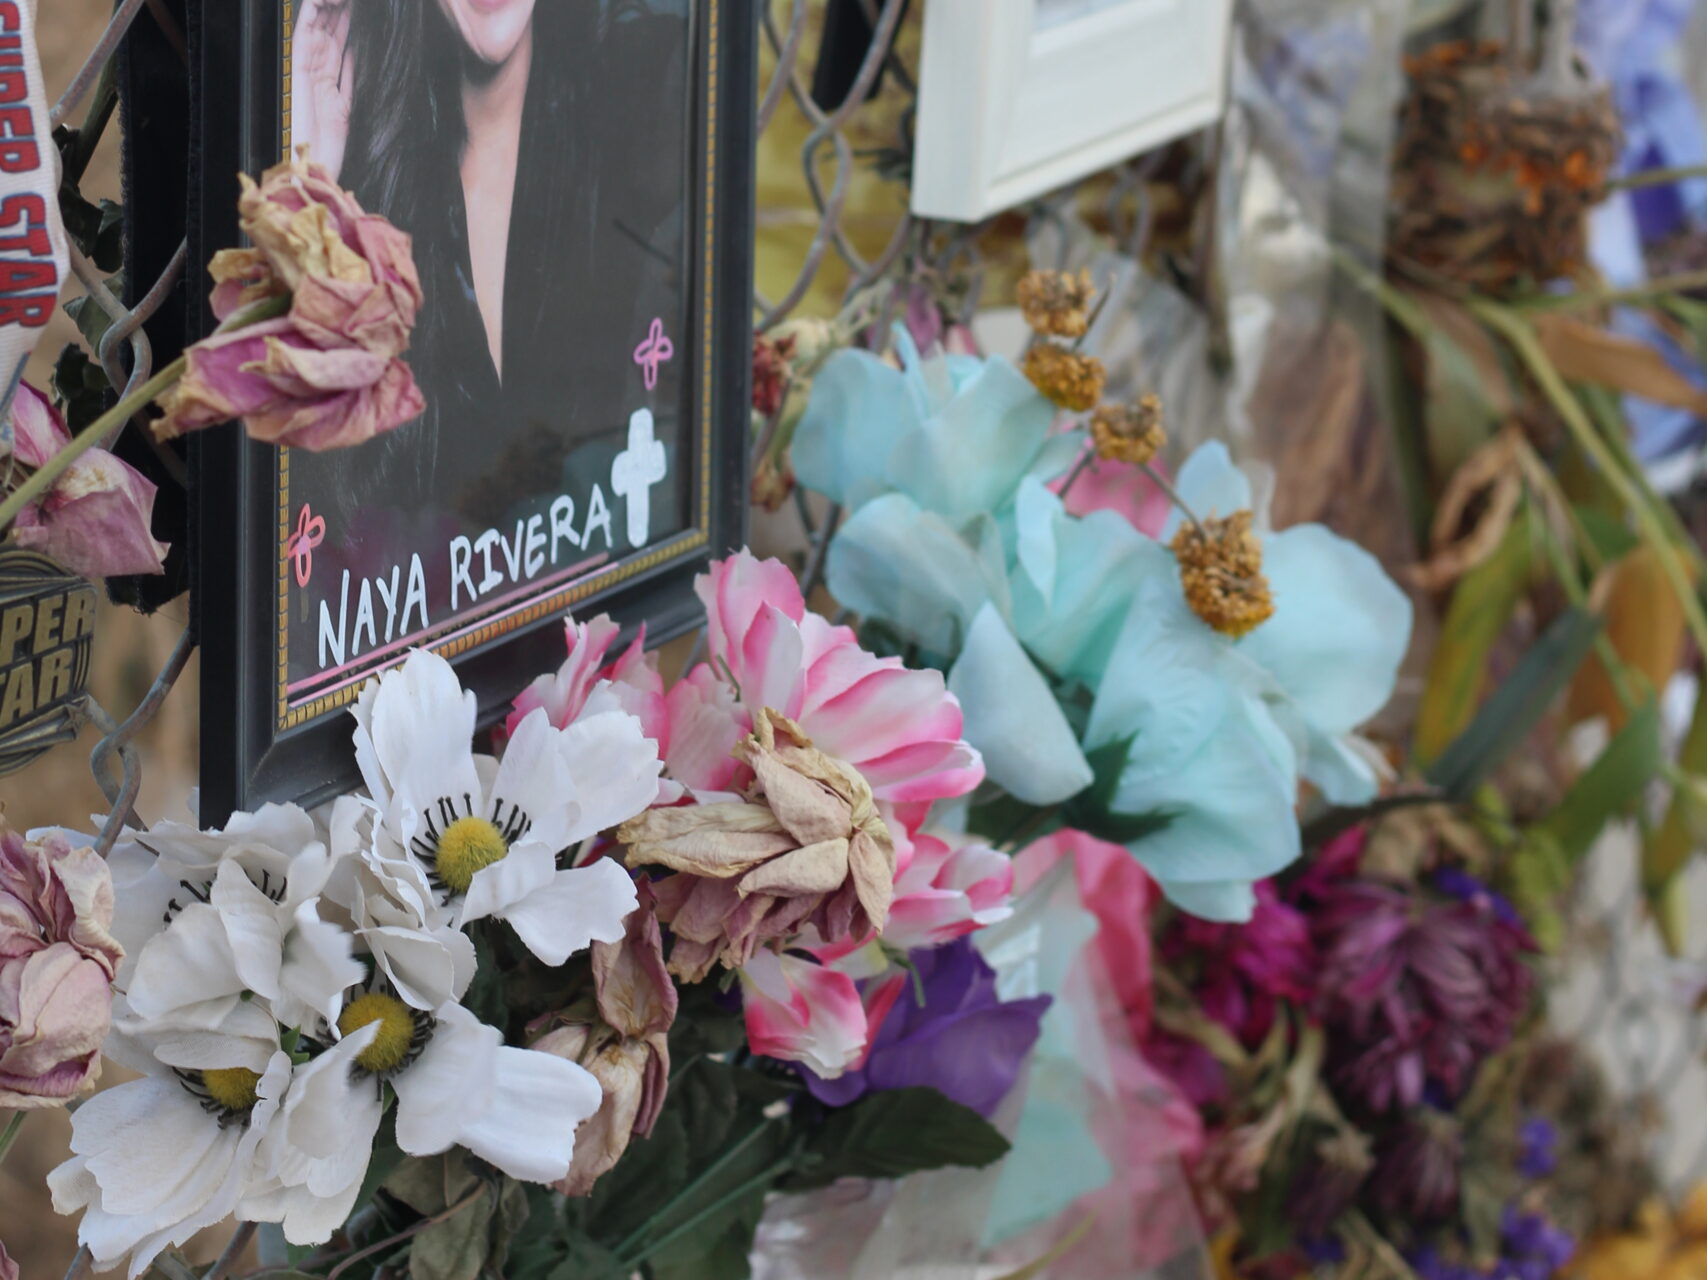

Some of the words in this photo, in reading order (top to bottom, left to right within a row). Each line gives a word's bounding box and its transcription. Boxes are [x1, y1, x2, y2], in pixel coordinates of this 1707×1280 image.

[0, 192, 58, 328] STAR
[318, 553, 429, 669] NAYA
[450, 483, 613, 610] RIVERA
[0, 648, 74, 728] AR
